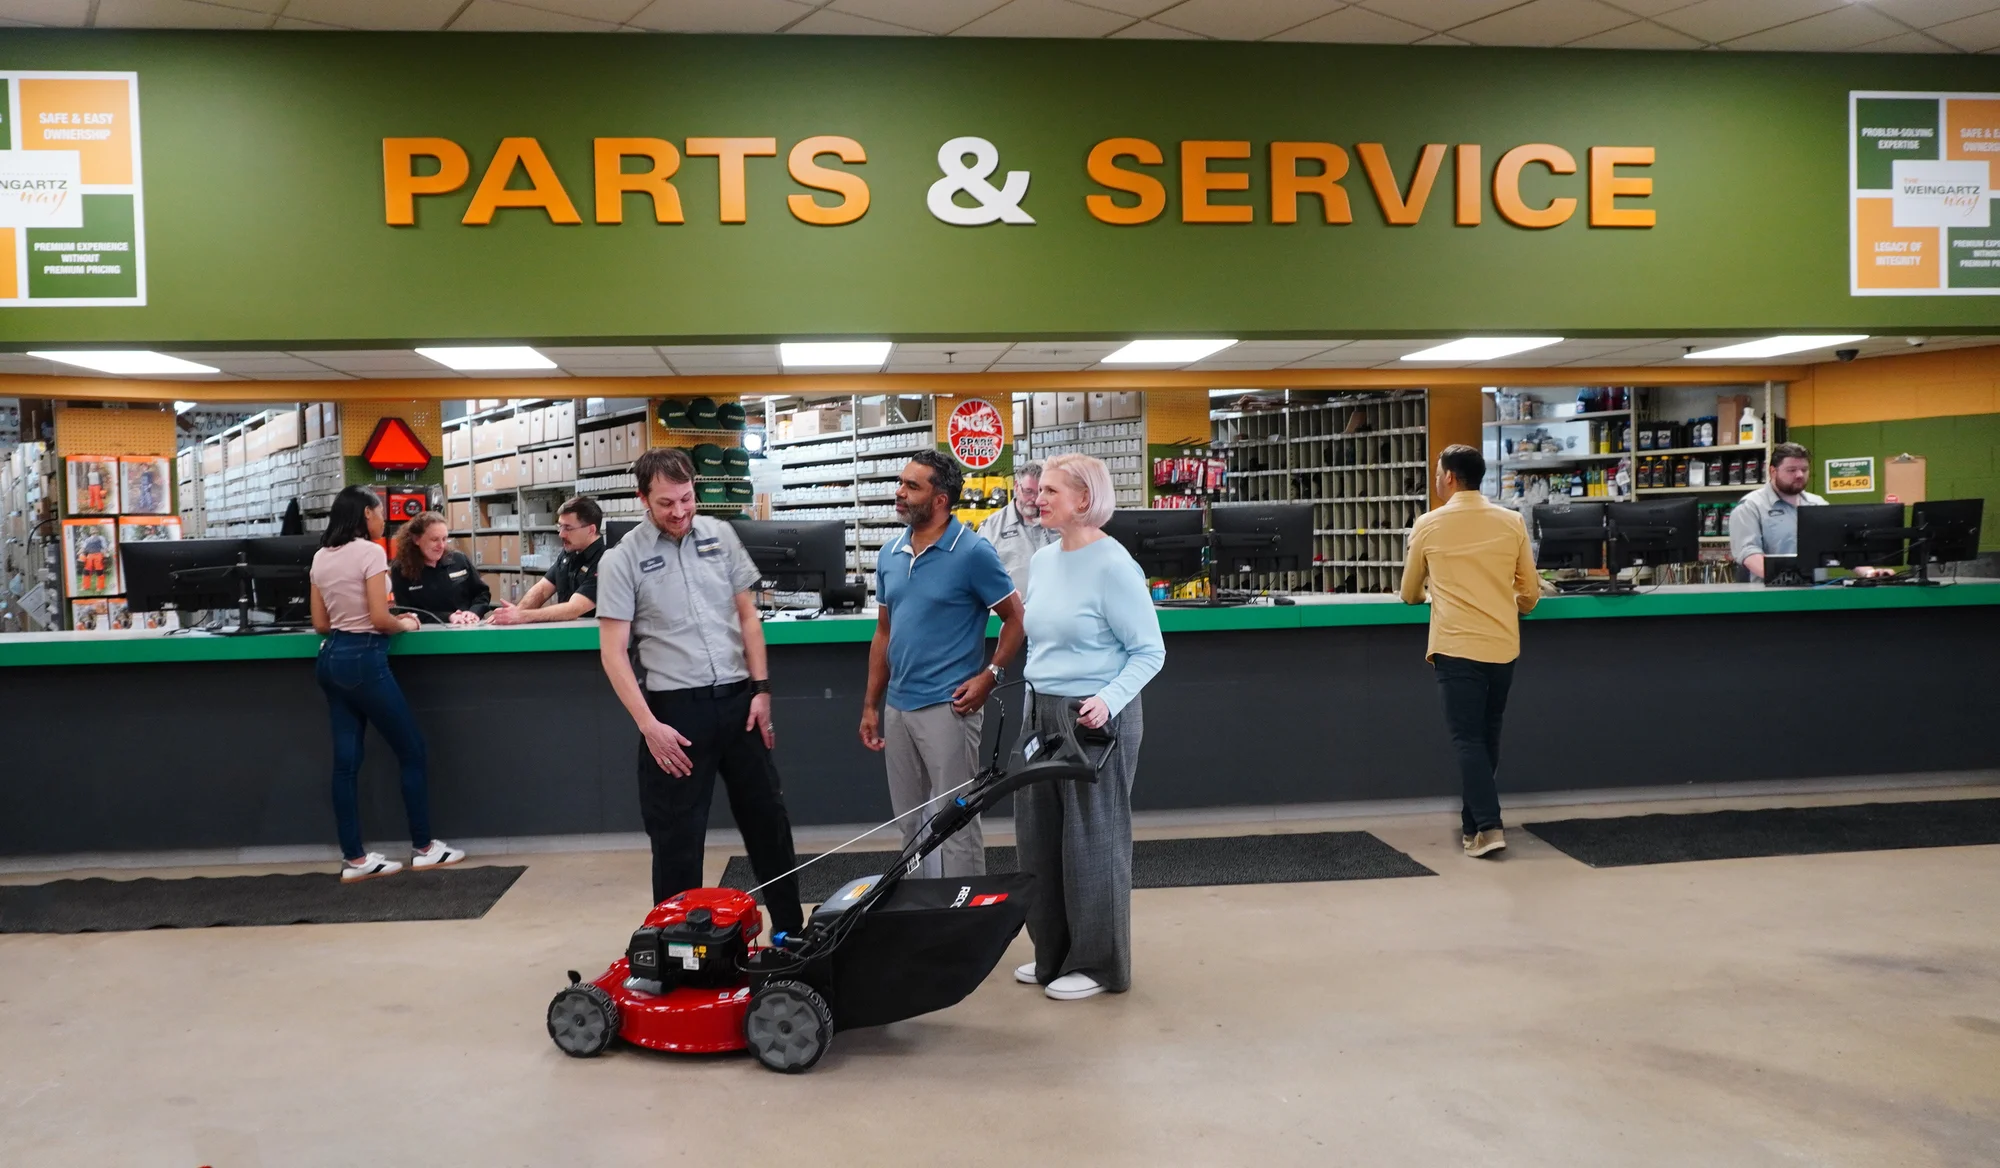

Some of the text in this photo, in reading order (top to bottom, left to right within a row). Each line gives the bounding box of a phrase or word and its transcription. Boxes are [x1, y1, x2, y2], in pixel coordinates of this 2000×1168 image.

[39, 112, 113, 124] SAFE & EASY
[43, 128, 111, 140] OWNERSHIP
[1861, 127, 1934, 138] PROBLEM-SOLVING
[1960, 127, 1983, 139] SAFE
[1878, 139, 1920, 150] EXPERTISE
[382, 135, 1657, 229] PARTS & SERVICE
[1904, 185, 1981, 195] WEINGARTZ
[20, 191, 67, 215] way
[1944, 195, 1980, 216] way
[34, 242, 129, 251] PREMIUM EXPERIENCE
[1874, 241, 1923, 253] LEGACY OF
[1952, 239, 1984, 248] PREMIUM
[61, 253, 100, 263] WITHOUT
[1875, 255, 1921, 266] INTEGRITY
[1960, 259, 1991, 268] PREMIUM
[43, 265, 121, 275] PREMIUM PRICING
[953, 413, 996, 434] NGK
[959, 437, 994, 447] SPARK
[960, 447, 995, 457] PLUGS
[1831, 460, 1868, 468] Oregon
[1832, 478, 1869, 488] $54.50
